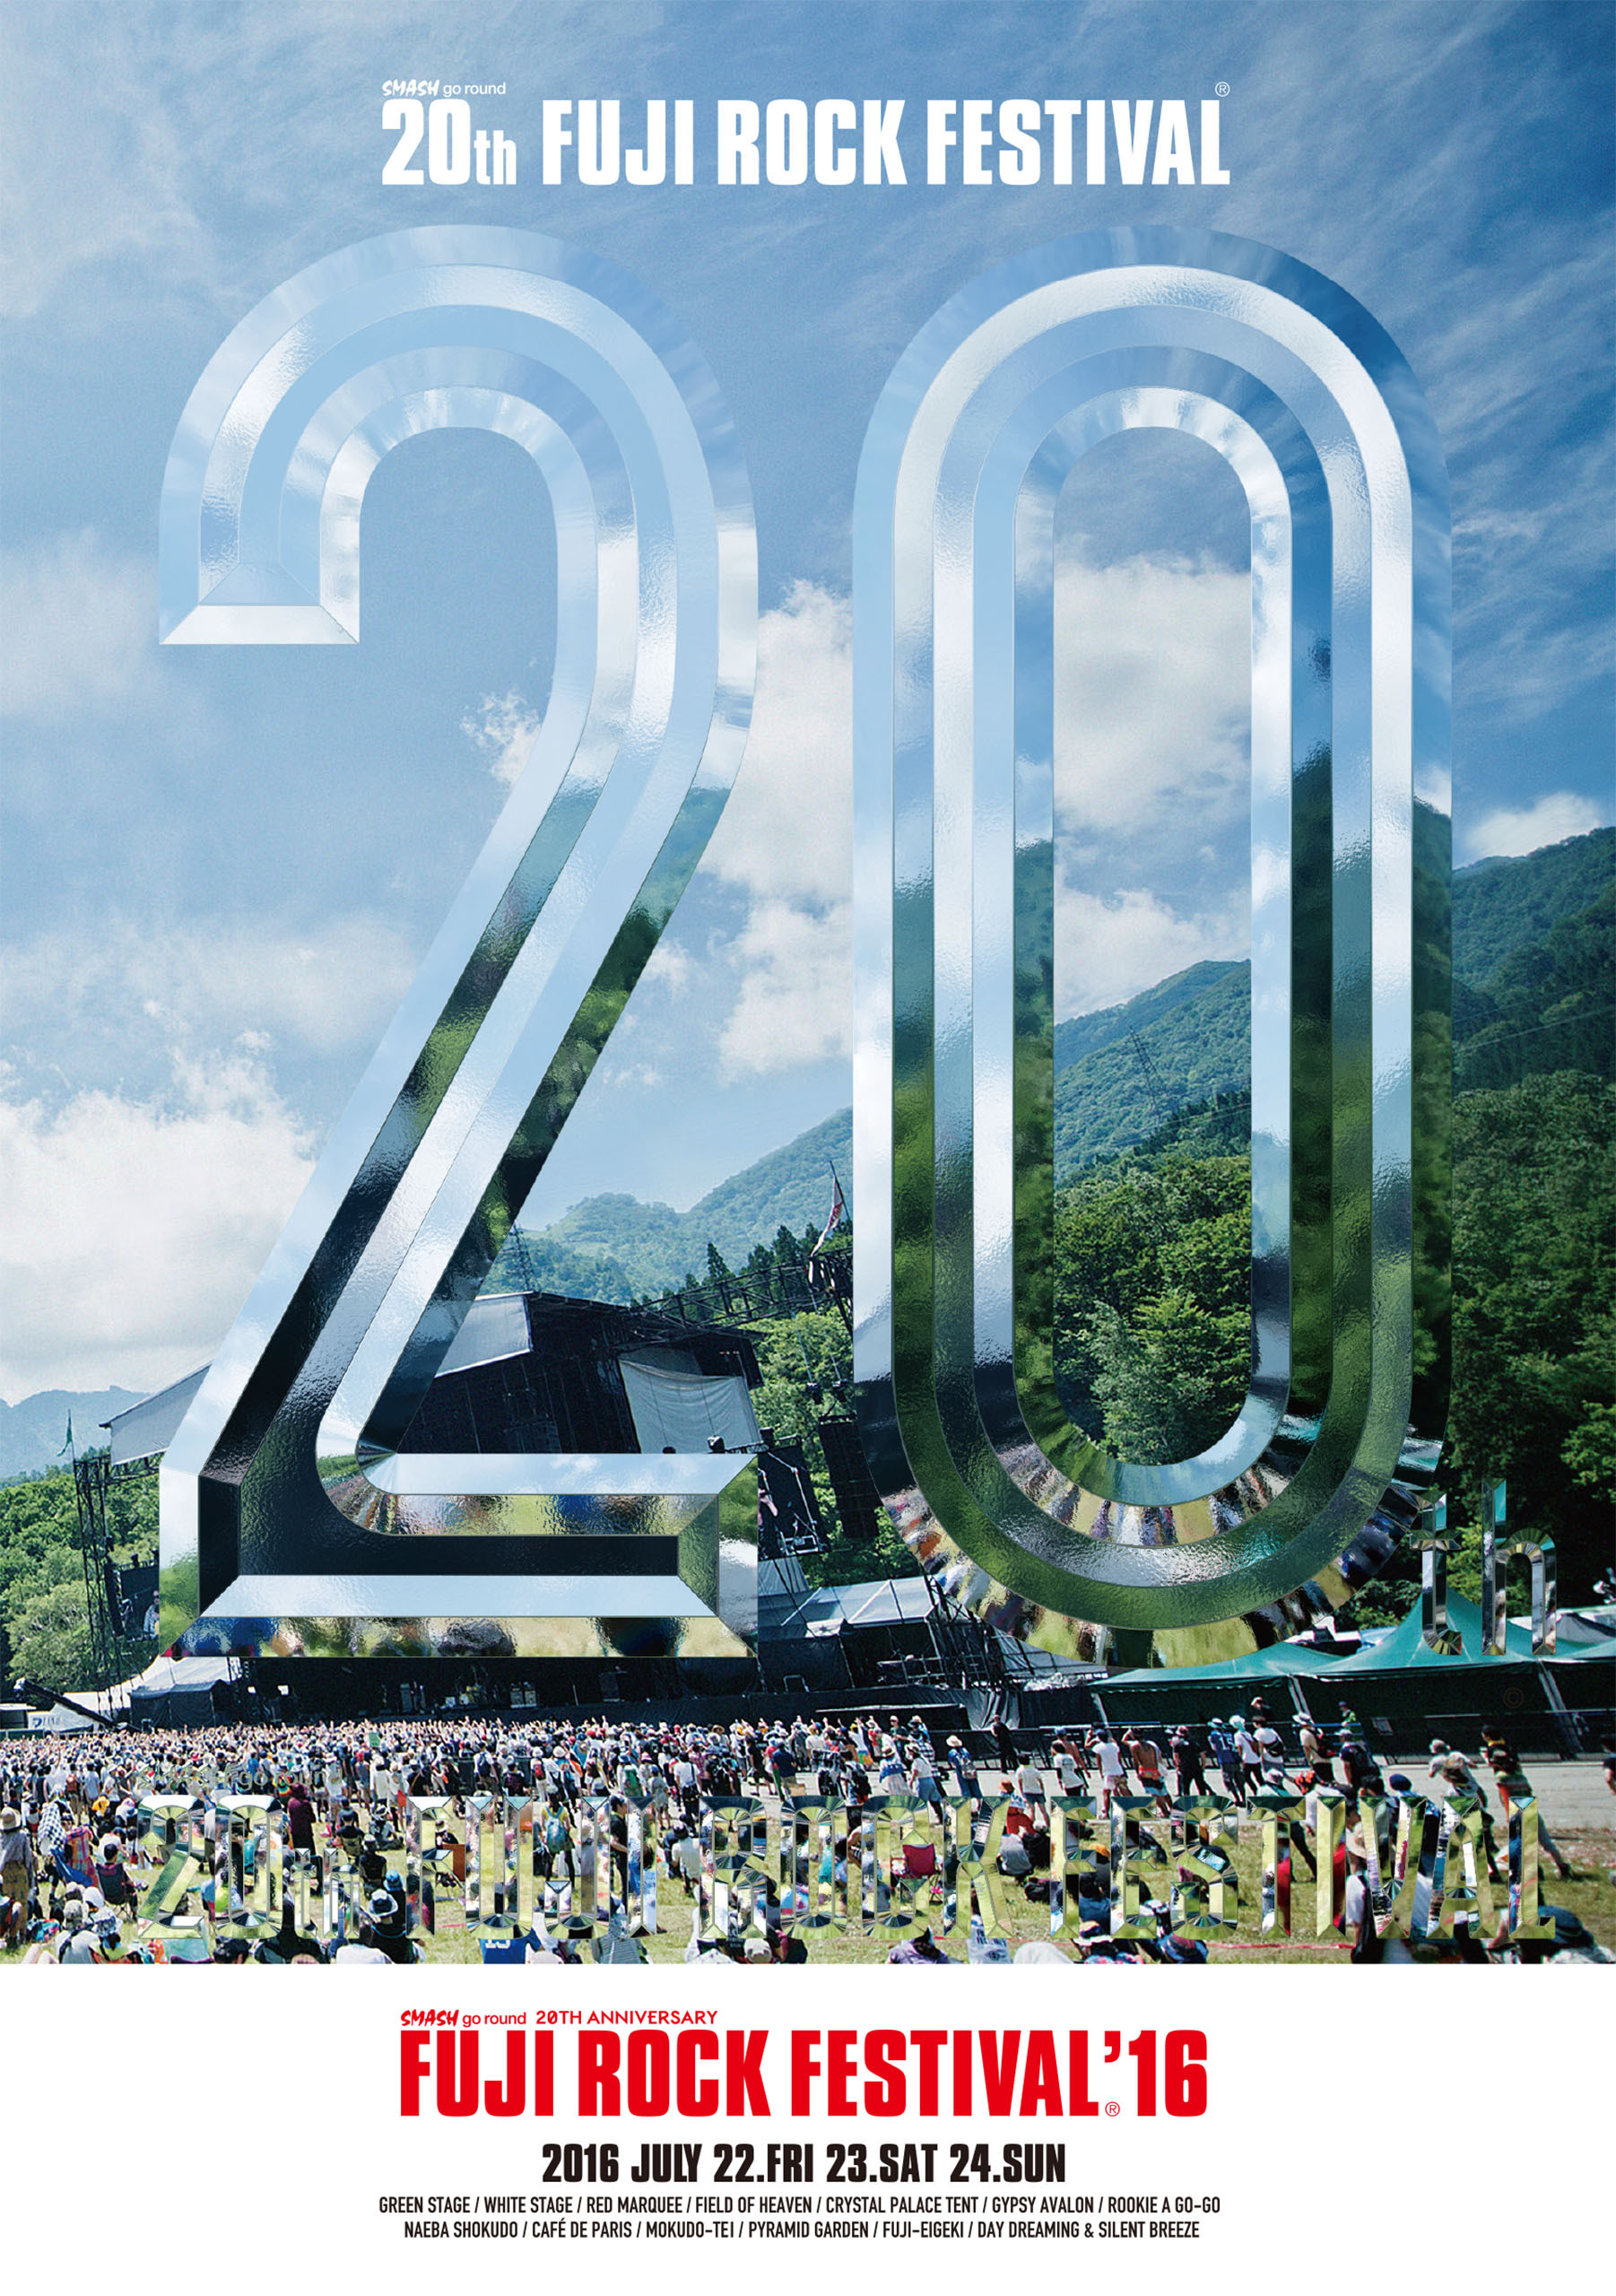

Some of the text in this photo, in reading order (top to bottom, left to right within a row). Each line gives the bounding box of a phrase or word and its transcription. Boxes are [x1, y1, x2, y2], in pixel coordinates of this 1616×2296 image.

[382, 78, 507, 98] SMASH go round
[381, 100, 517, 186] 20th
[543, 100, 694, 186] FUJI
[717, 99, 908, 186] ROCK
[927, 99, 1230, 186] FESTIVAL
[137, 1794, 1556, 1940] 20th FUJI ROCK FESTIVAL
[400, 2008, 718, 2029] SMASH go round 20TH ANNIVERSARY
[400, 2030, 554, 2118] FUJI
[578, 2029, 772, 2118] ROCK
[543, 2144, 1064, 2182] 2016 JULY 22.FRI 23.SAT 24.SUN
[379, 2196, 422, 2213] GREEN
[428, 2196, 470, 2213] STAGE
[484, 2196, 526, 2213] WHITE
[531, 2196, 572, 2213] STAGE
[587, 2196, 613, 2213] RED
[618, 2196, 682, 2213] MARQUEE
[696, 2196, 733, 2213] FIELD
[738, 2196, 754, 2213] OF
[760, 2196, 812, 2213] HEAVEN
[827, 2196, 885, 2213] CRYSTAL
[891, 2196, 942, 2213] PALACE
[946, 2196, 978, 2213] TENT
[993, 2196, 1036, 2213] GYPSY
[1040, 2196, 1093, 2213] AVALON
[1108, 2196, 1158, 2213] ROOKIE
[1162, 2196, 1170, 2213] A
[1176, 2196, 1220, 2213] GO-GO
[405, 2222, 449, 2238] NAEBA
[454, 2222, 517, 2238] SHOKUDO
[533, 2218, 566, 2238] CAFÉ
[571, 2222, 587, 2238] DE
[593, 2222, 631, 2238] PARIS
[647, 2222, 734, 2238] MOKUDO-TEI
[749, 2222, 809, 2238] PYRAMID
[815, 2222, 868, 2238] GARDEN
[883, 2222, 963, 2238] FUJI-EIGEKI
[978, 2222, 1004, 2238] DAY
[1009, 2222, 1079, 2238] DREAMING
[1084, 2223, 1093, 2238] &
[1099, 2222, 1145, 2238] SILENT
[1150, 2222, 1199, 2238] BREEZE
